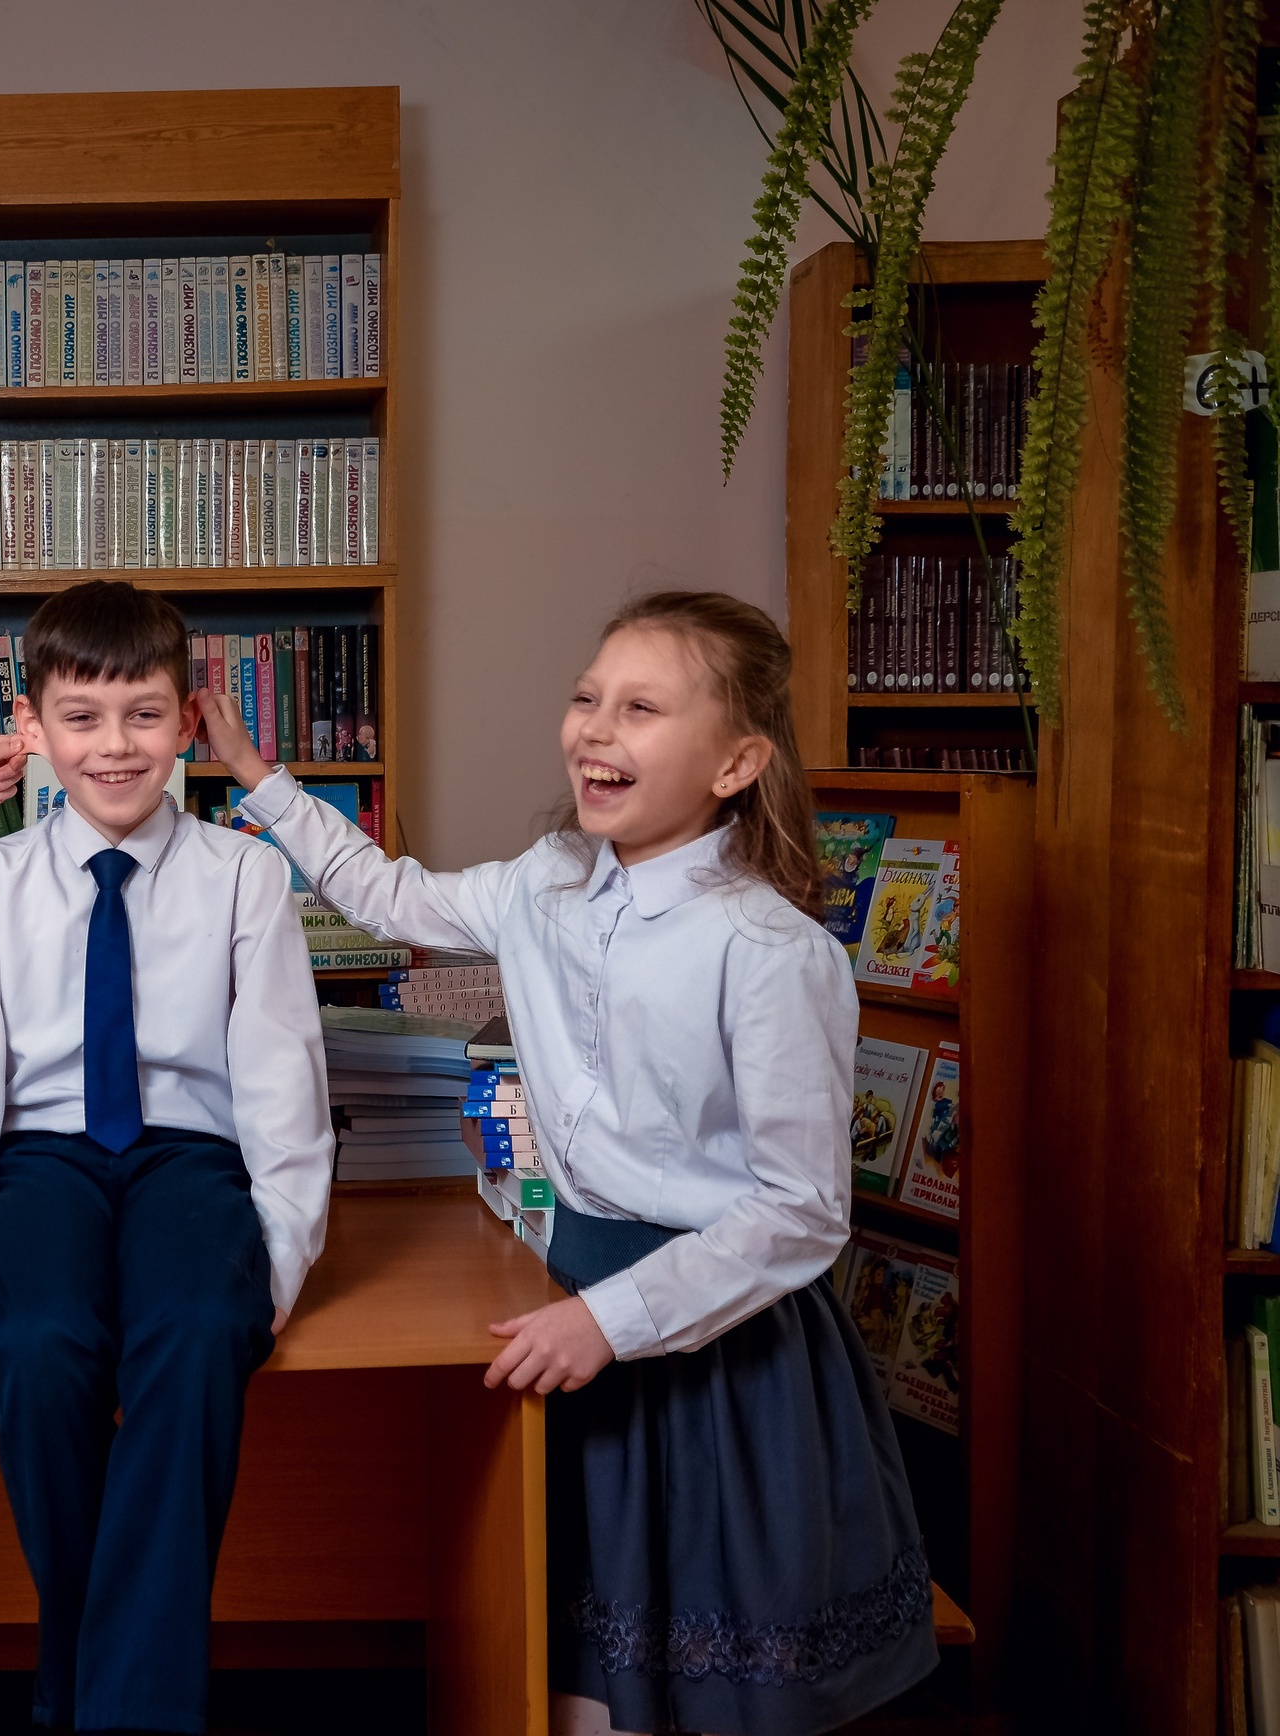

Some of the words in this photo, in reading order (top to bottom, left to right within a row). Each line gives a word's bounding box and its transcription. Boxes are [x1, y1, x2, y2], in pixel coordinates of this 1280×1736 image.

[184, 284, 193, 310] МИР
[368, 280, 378, 306] МИР
[65, 294, 75, 318] МИР
[64, 322, 75, 368] ПОЗНАЮ
[184, 314, 195, 364] ПОЗНАЮ
[367, 310, 379, 360] ПОЗНАЮ
[64, 372, 74, 380] Я
[183, 368, 195, 377] Я
[366, 363, 378, 372] Я
[95, 464, 106, 493] МИР
[348, 465, 359, 491] МИР
[95, 498, 105, 549] ПОЗНАЮ
[348, 495, 358, 548] ПОЗНАЮ
[95, 552, 105, 561] Я
[348, 551, 357, 559] Я
[229, 640, 236, 658] 6
[260, 637, 269, 662] 8
[197, 667, 205, 688] СЕХ
[213, 665, 221, 694] ВСЕХ
[231, 665, 239, 693] ВСЕХ
[243, 662, 253, 691] ВСЕХ
[262, 665, 270, 694] ВСЕХ
[1, 680, 12, 701] ВСЕ
[245, 694, 253, 717] ОБО
[263, 697, 271, 719] ОБО
[880, 863, 936, 885] Бианки
[311, 955, 330, 967] МИ
[335, 954, 388, 966] ПОЗНАЮ
[391, 952, 400, 965] Я
[866, 960, 911, 977] Сказки
[884, 1052, 905, 1062] Машков
[895, 1372, 949, 1400] СМЕШНЫЕ
[1261, 1378, 1271, 1418] животных
[1263, 1421, 1272, 1436] мире
